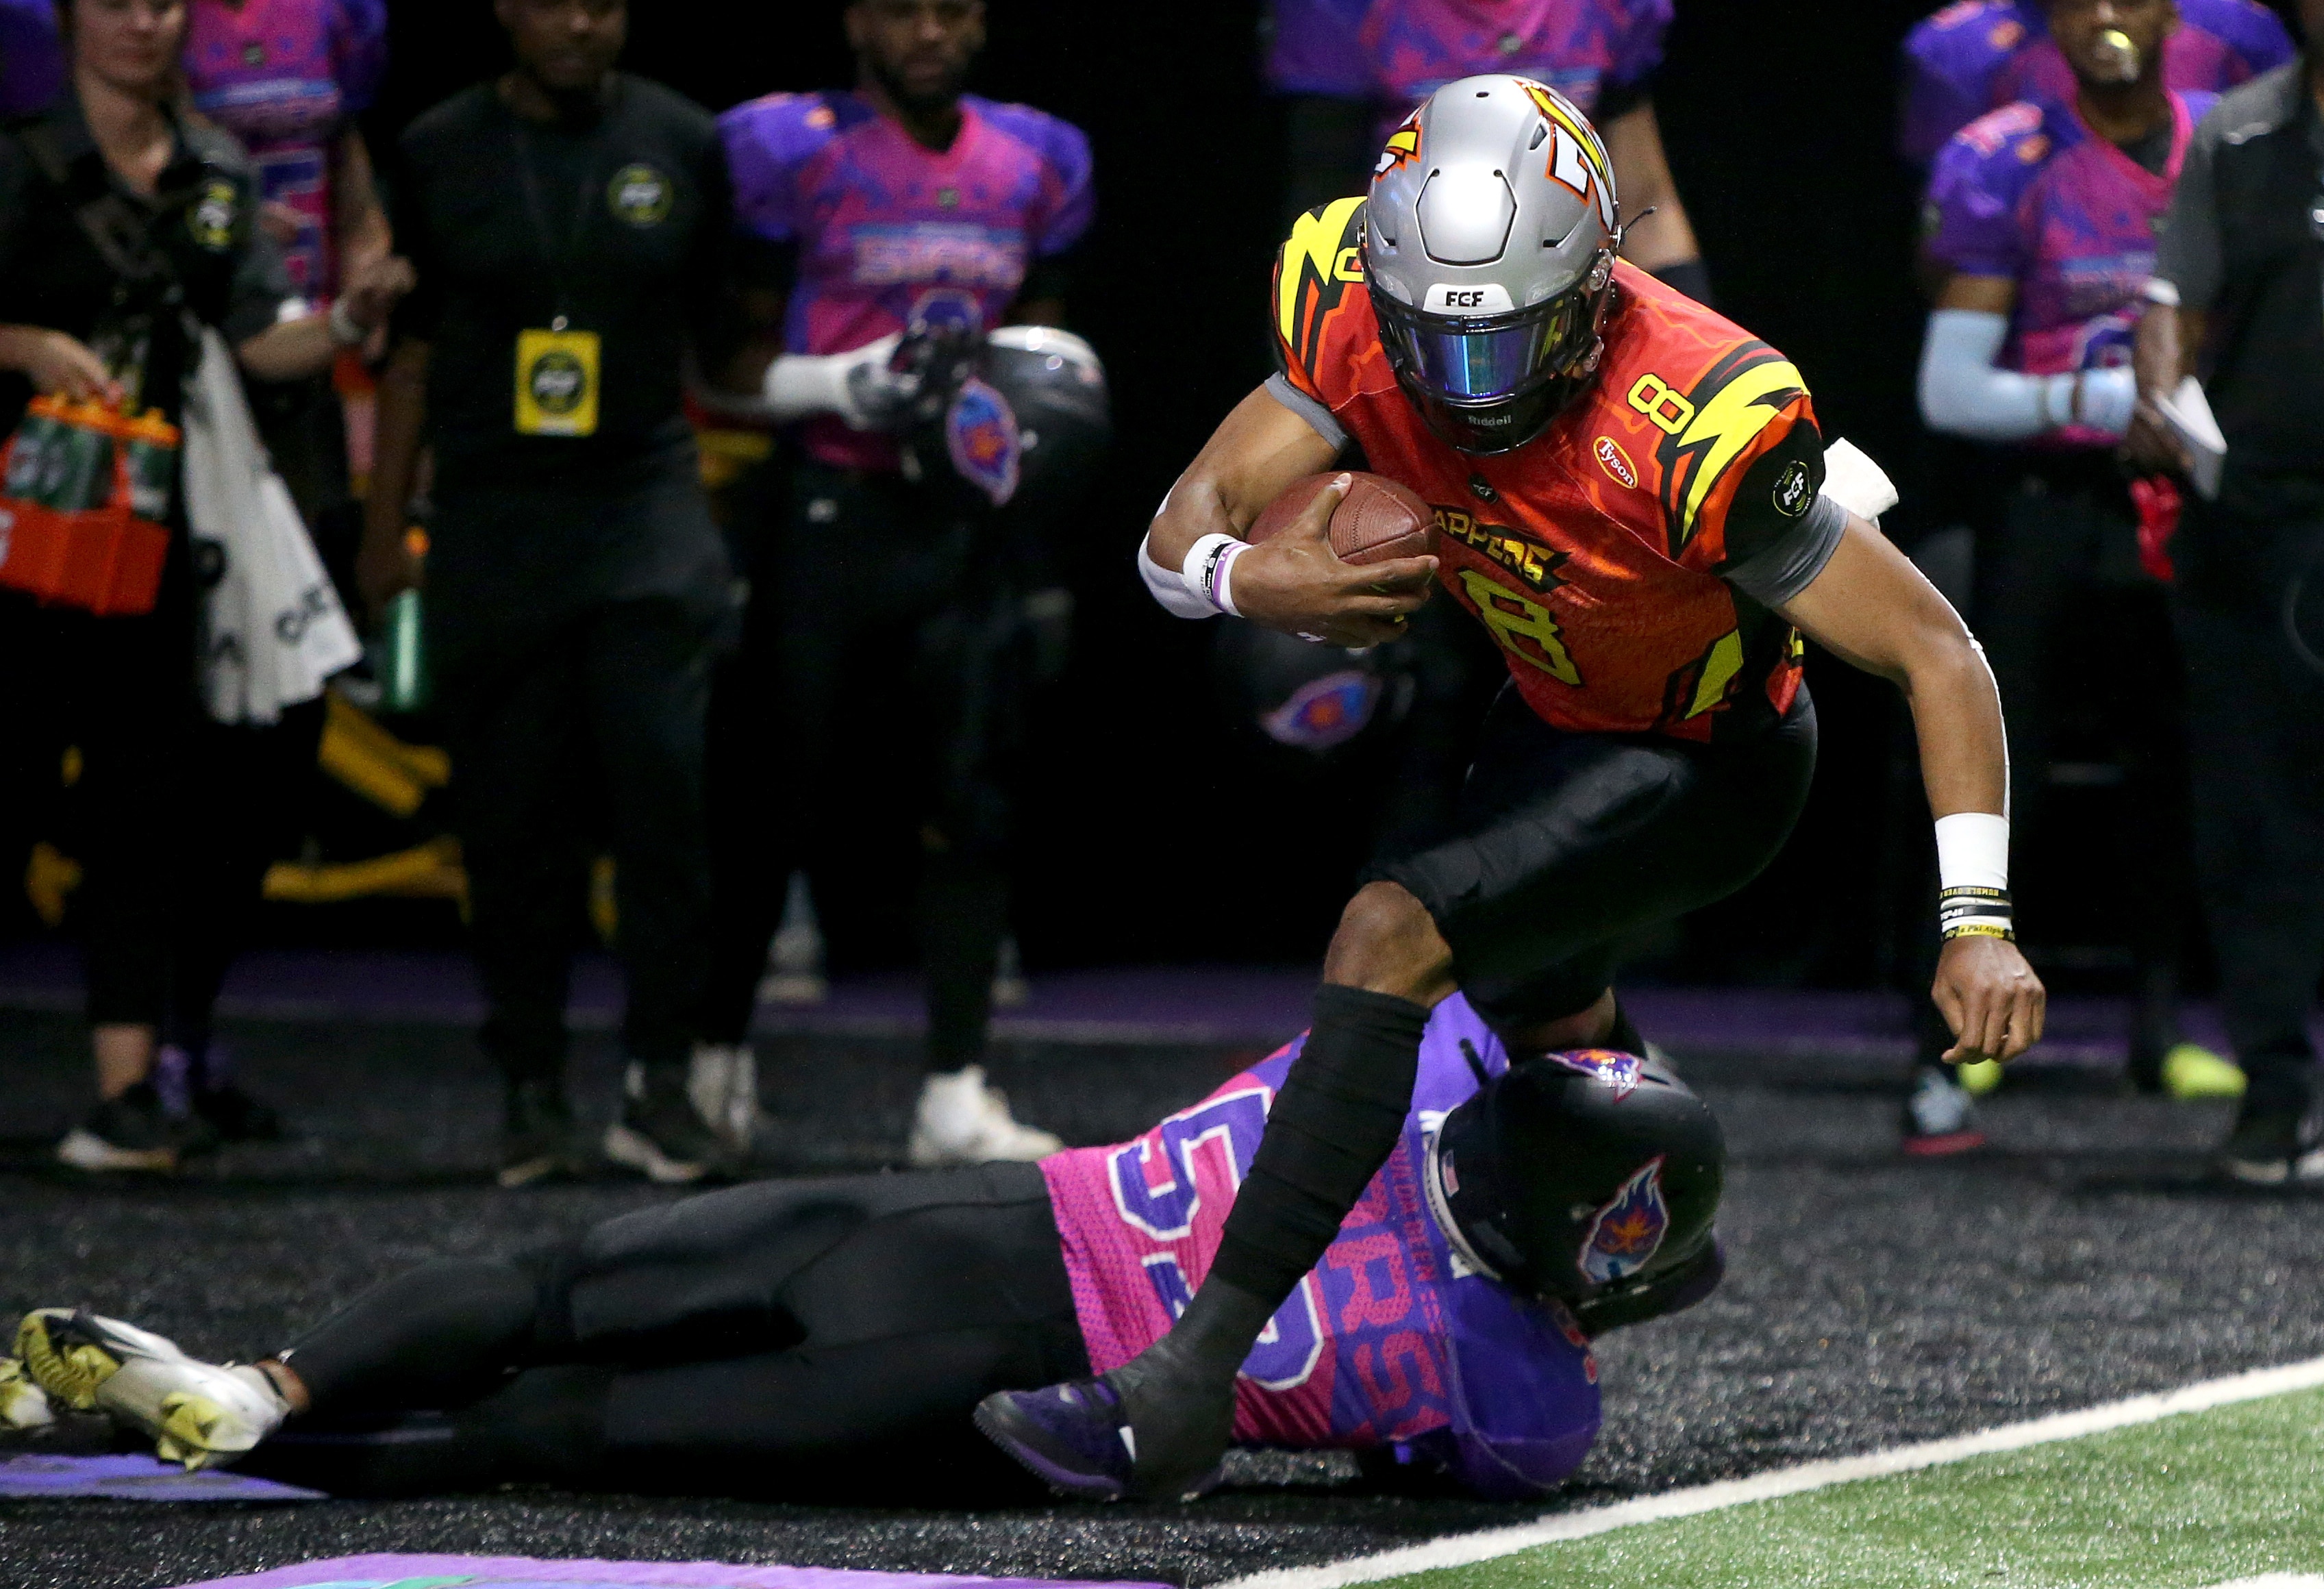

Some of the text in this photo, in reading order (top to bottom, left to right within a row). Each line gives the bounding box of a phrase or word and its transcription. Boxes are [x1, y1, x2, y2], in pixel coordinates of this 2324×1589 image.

[1446, 291, 1484, 307] FCF
[1468, 414, 1512, 426] Riddell
[1627, 373, 1695, 435] 8
[1599, 438, 1635, 486] Tyson
[1782, 471, 1804, 506] FCF
[1435, 510, 1555, 586] APPERS
[1458, 570, 1582, 685] 8
